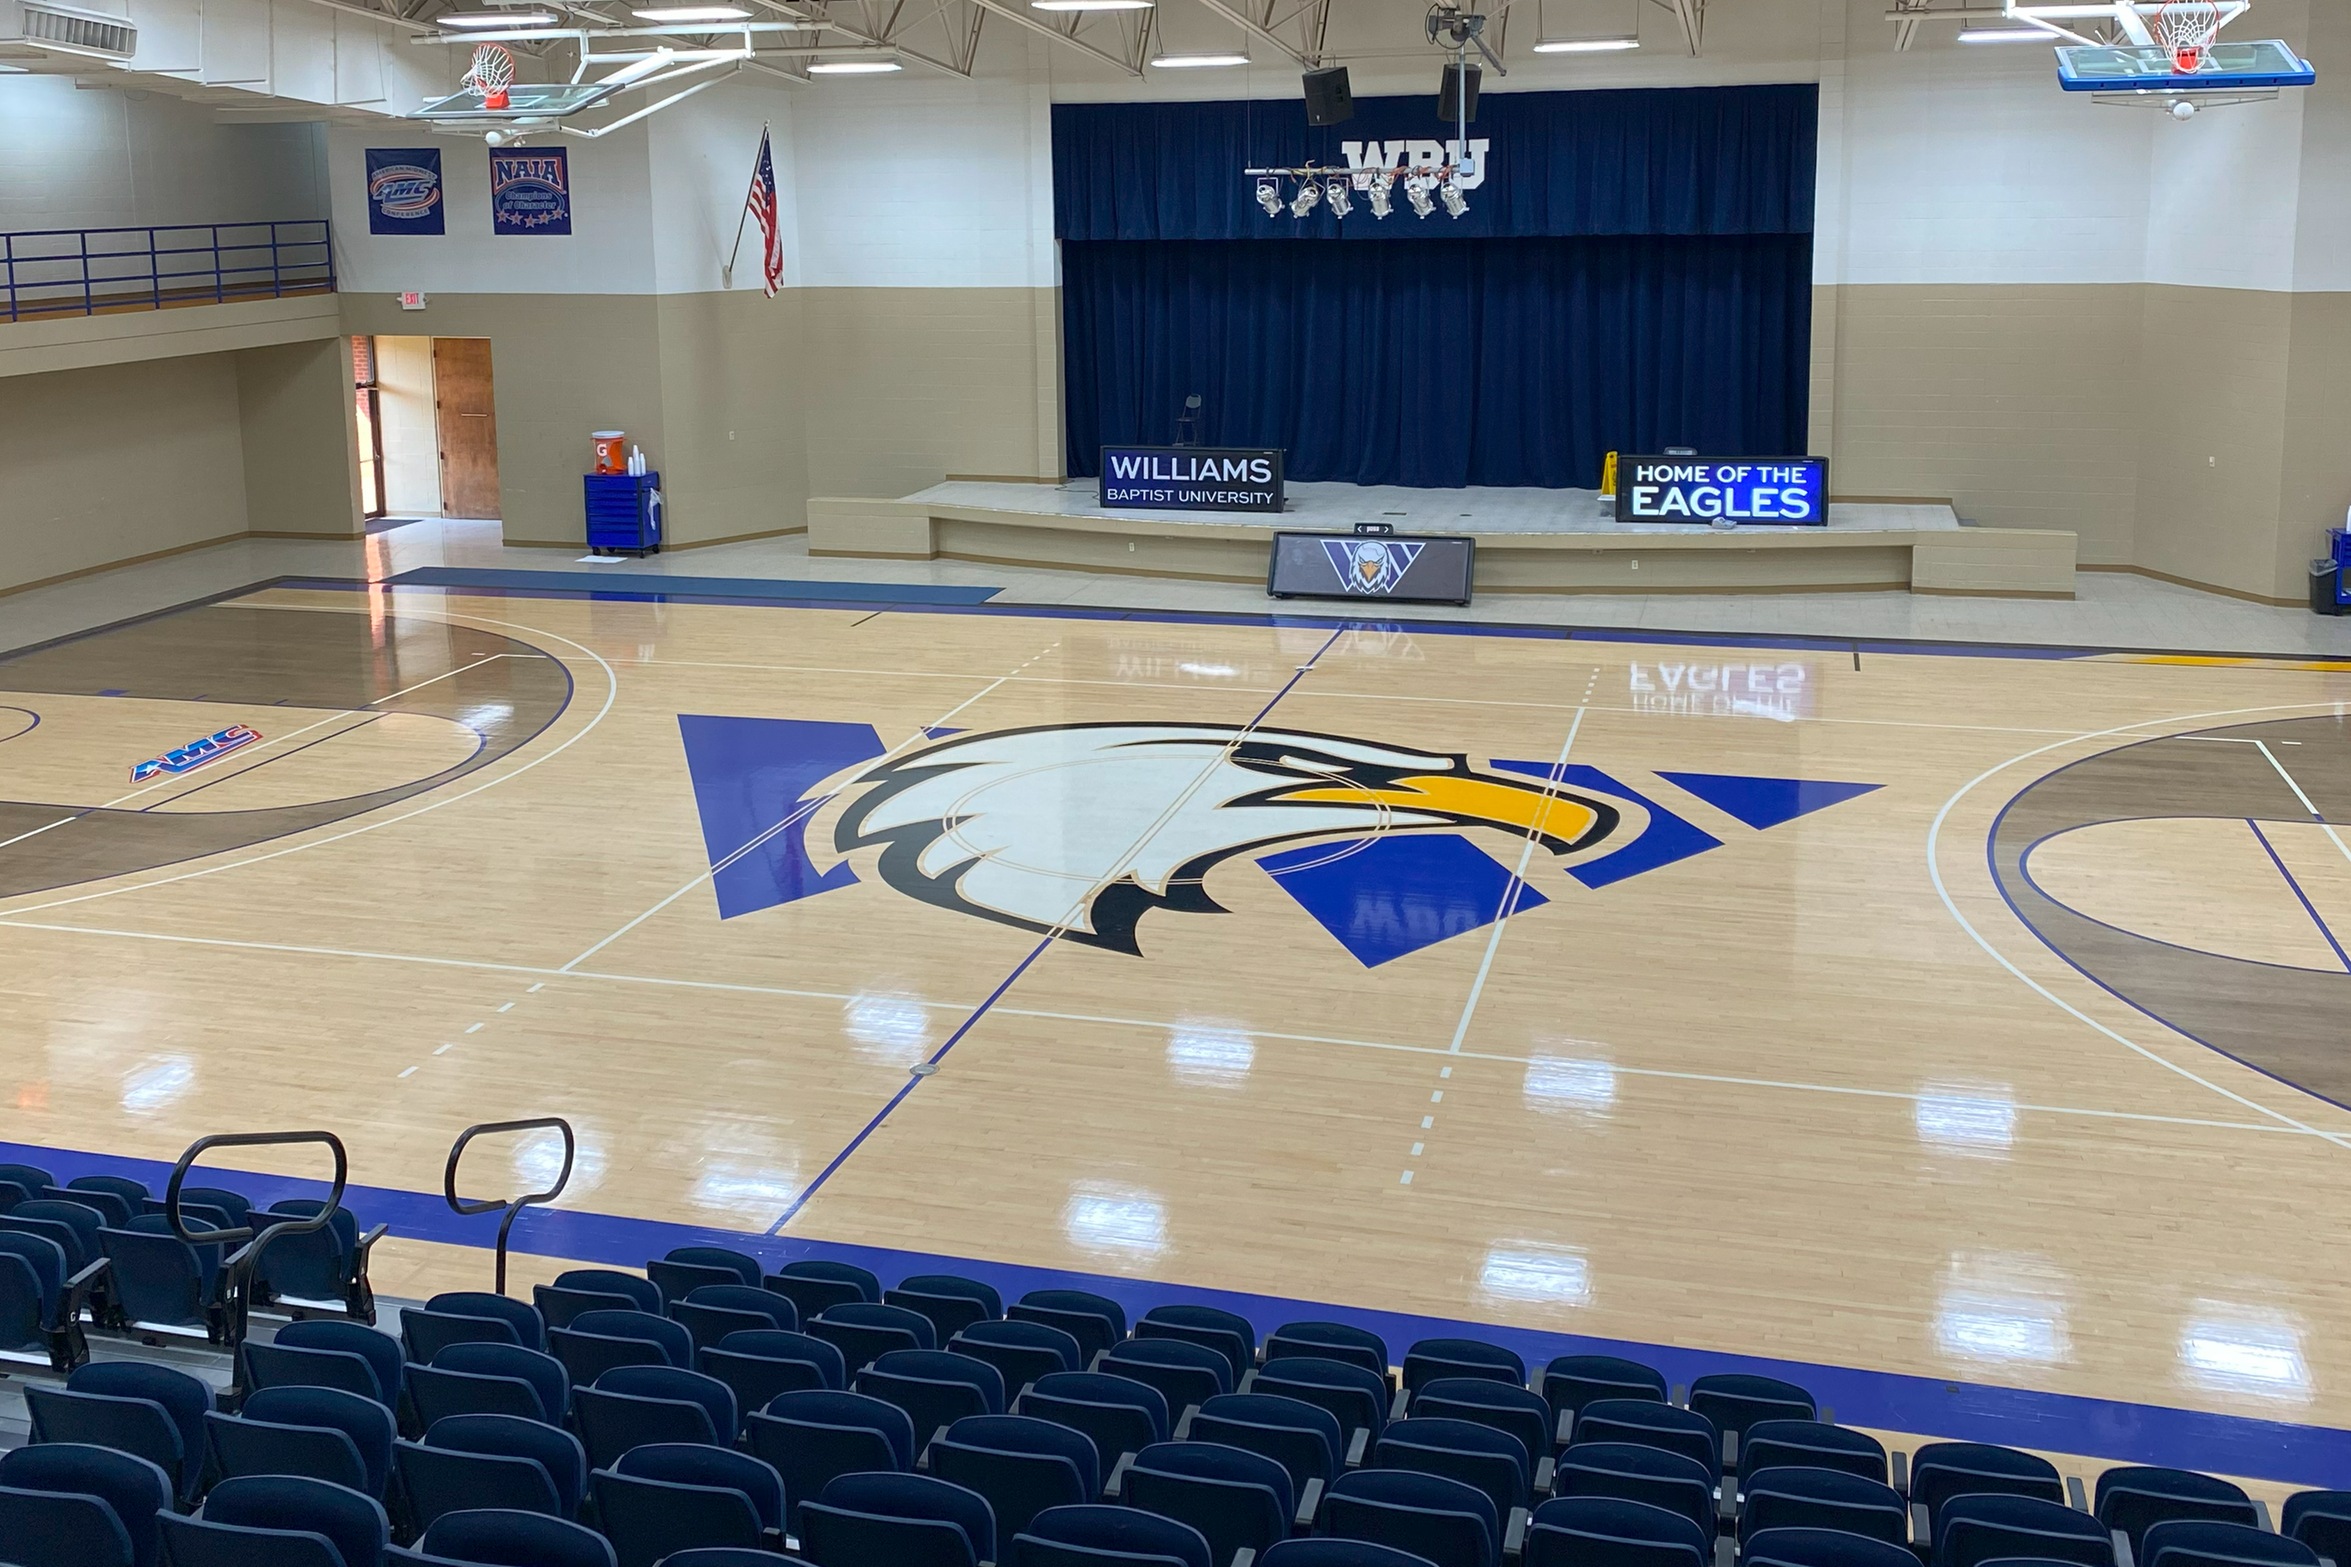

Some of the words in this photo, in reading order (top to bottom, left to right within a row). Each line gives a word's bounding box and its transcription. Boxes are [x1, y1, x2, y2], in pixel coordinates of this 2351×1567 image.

[373, 166, 405, 178] AMERICAN
[405, 166, 437, 179] MIDWEST
[1341, 139, 1489, 190] WBU
[494, 159, 562, 190] NAIA
[373, 180, 434, 204] AMC
[505, 191, 553, 201] Champions
[382, 208, 428, 217] CONFERENCE
[503, 201, 513, 209] of
[514, 201, 557, 210] Character
[405, 293, 419, 305] EXIT
[597, 443, 607, 457] G
[1111, 456, 1272, 483] WILLIAMS
[1637, 465, 1710, 482] HOME
[1717, 466, 1751, 483] OF
[1757, 467, 1807, 484] THE
[1107, 488, 1174, 501] BAPTIST
[1179, 491, 1274, 504] UNIVERSITY
[1632, 486, 1810, 519] EAGLES
[129, 724, 264, 784] AMC
